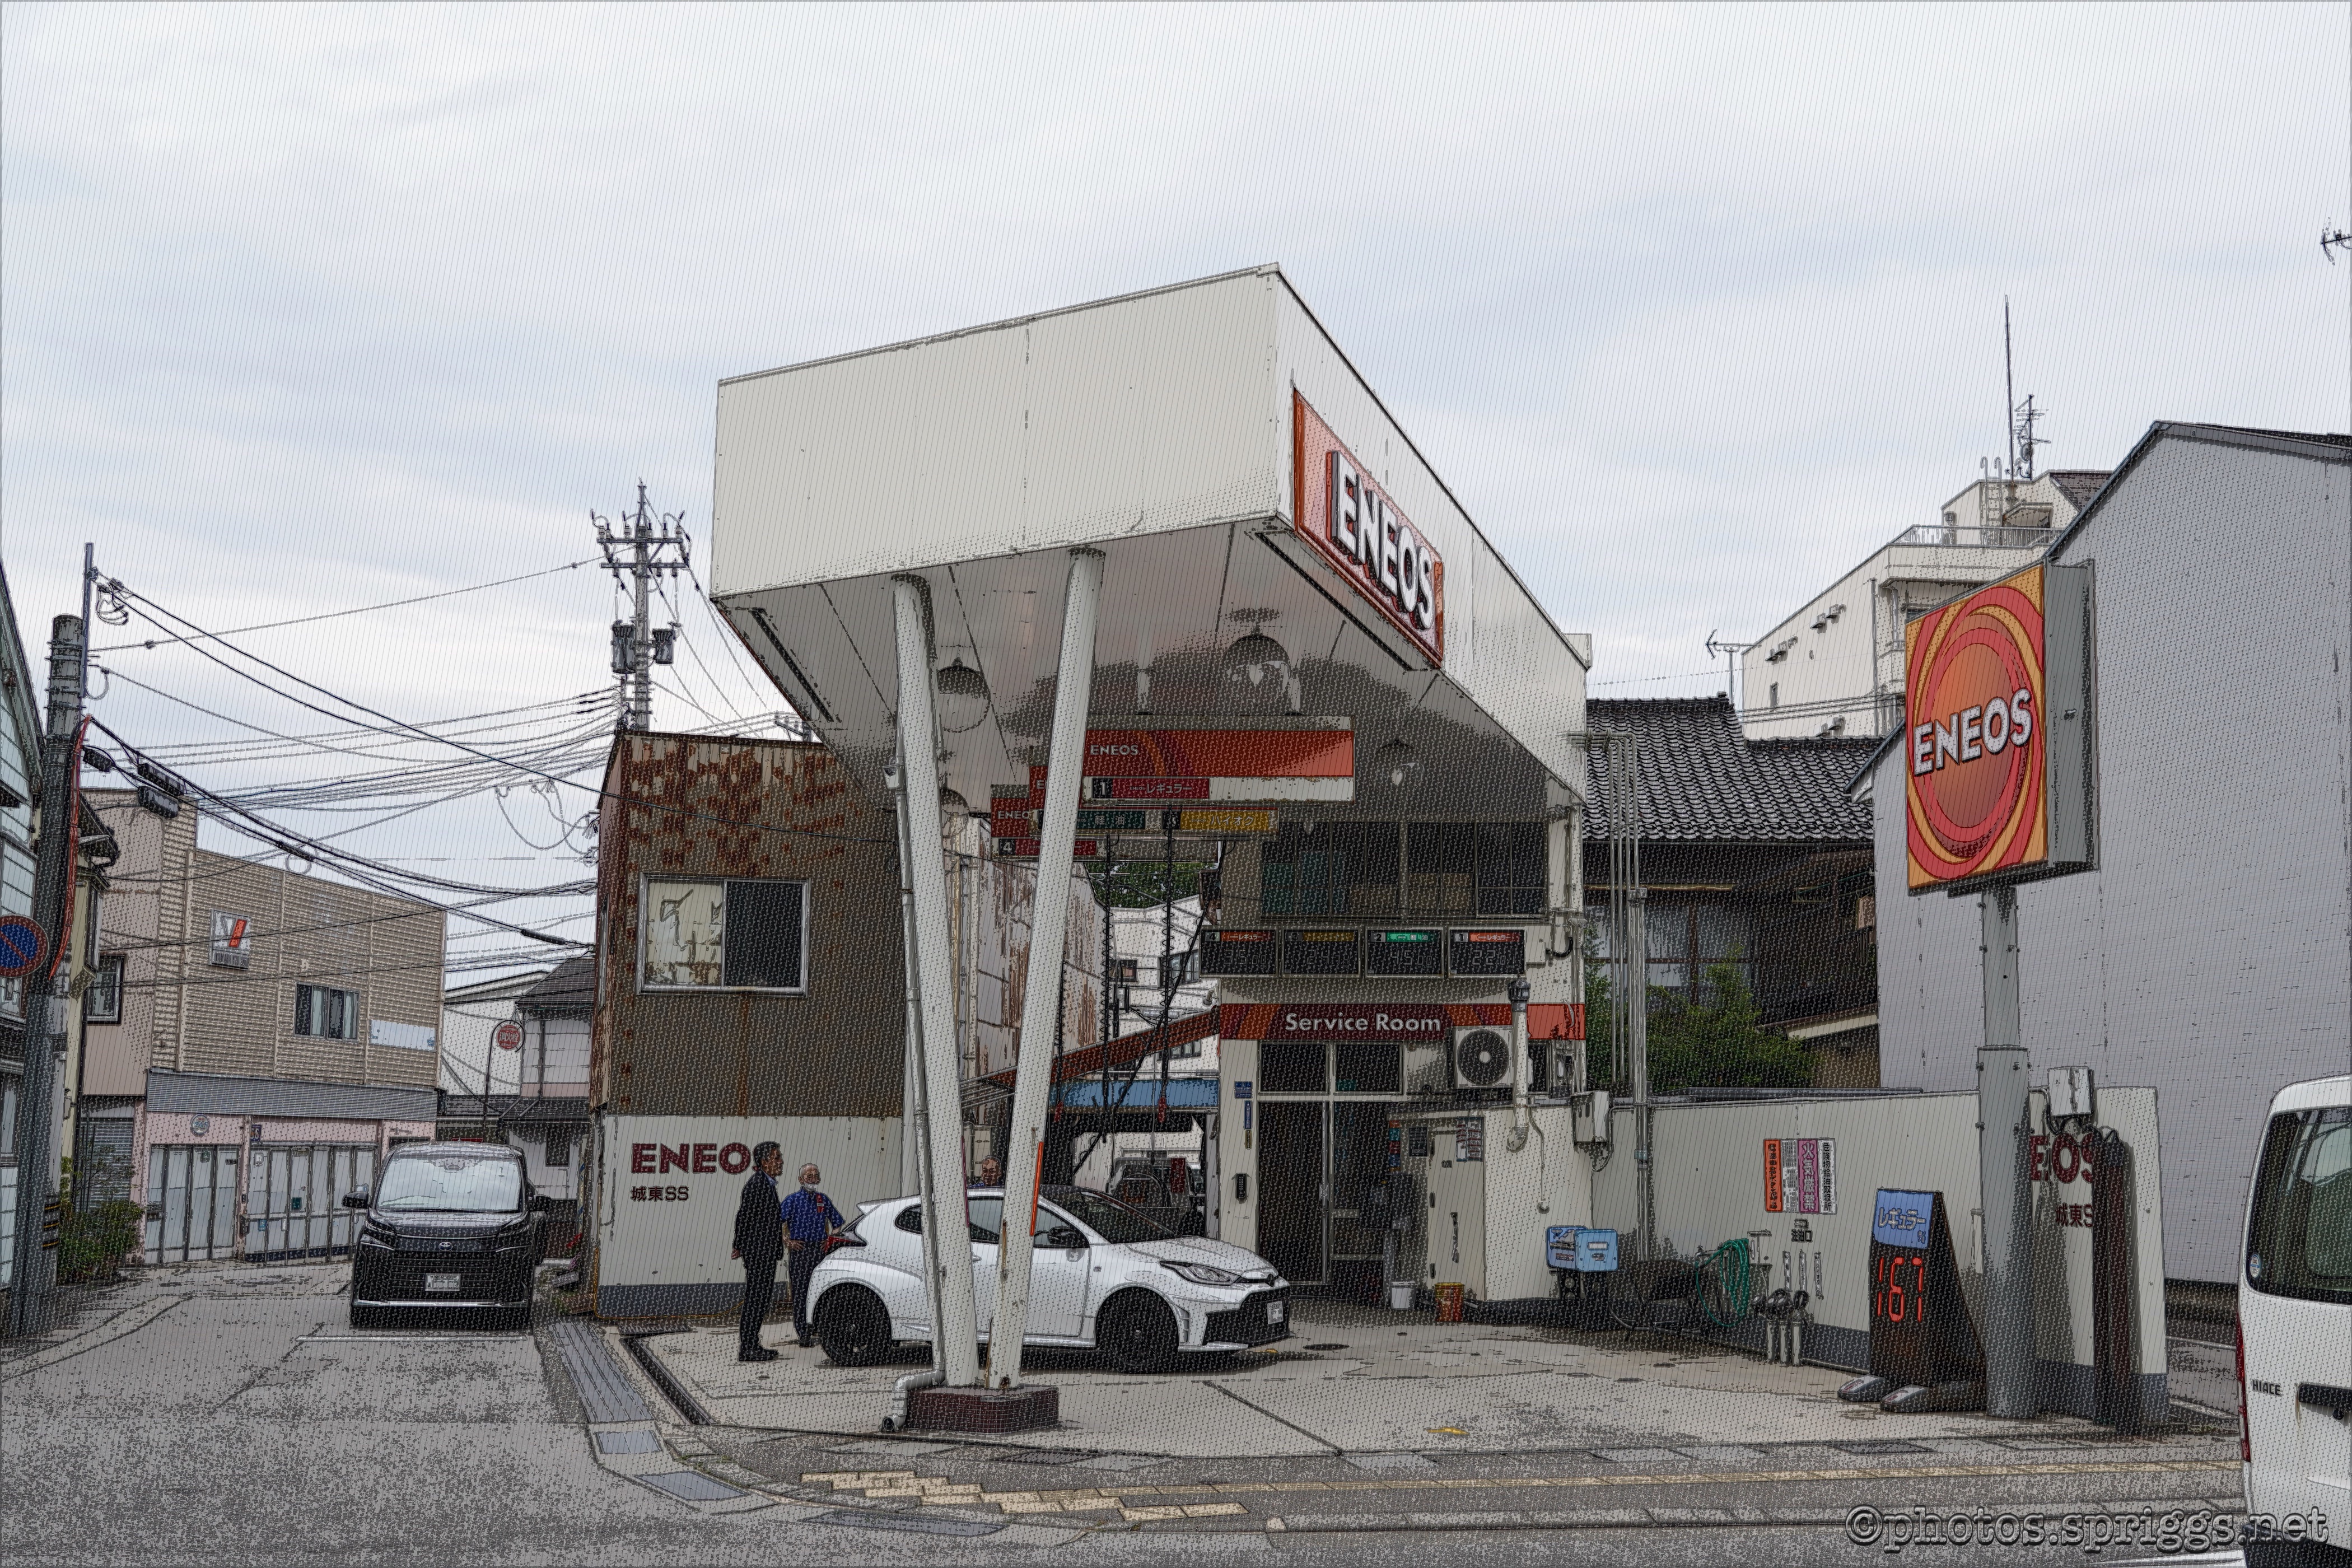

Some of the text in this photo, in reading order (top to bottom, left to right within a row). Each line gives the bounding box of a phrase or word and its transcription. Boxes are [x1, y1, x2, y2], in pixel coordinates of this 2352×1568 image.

[1331, 451, 1435, 629] ENEOS
[1913, 689, 2033, 777] ENEOS
[1090, 744, 1139, 755] ENEOS
[1100, 782, 1106, 795] 1
[1146, 783, 1192, 794] レギュラー
[1210, 815, 1254, 827] ハイオク
[1002, 842, 1012, 852] 4
[1285, 1011, 1441, 1031] Service Room
[499, 1032, 519, 1043] 消火栓
[632, 1143, 759, 1174] ENEO
[1802, 1141, 1815, 1210] 火気厳禁
[1823, 1142, 1831, 1211] 危険物給油取扱所
[631, 1186, 689, 1201] 城東SS
[1878, 1207, 1926, 1230] レギュラー
[1791, 1229, 1812, 1242] 注油口
[1877, 1257, 1925, 1323] 167
[2252, 1379, 2282, 1396] HIACE
